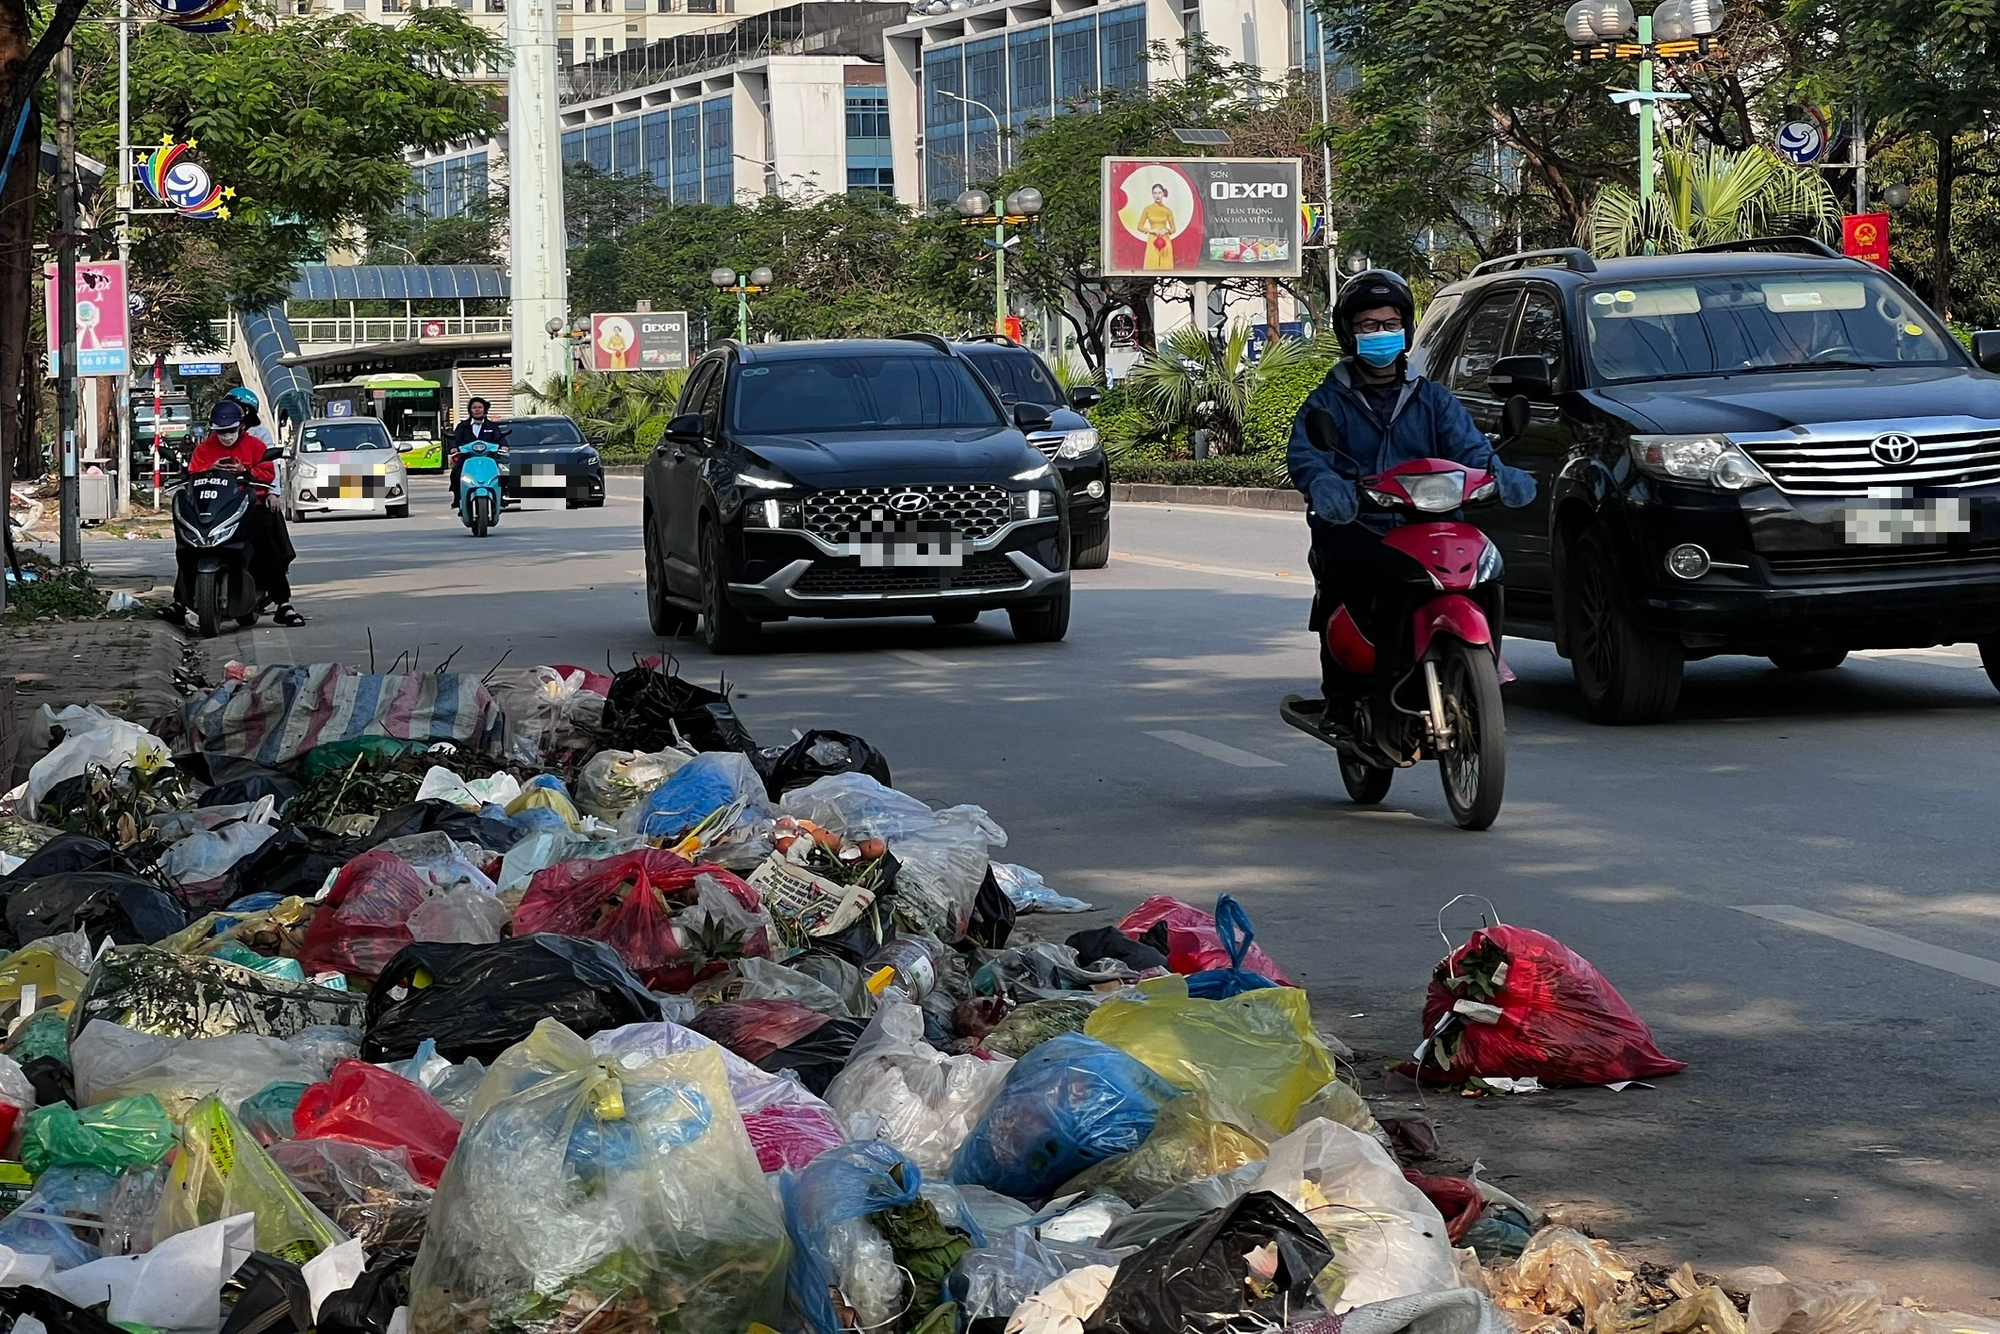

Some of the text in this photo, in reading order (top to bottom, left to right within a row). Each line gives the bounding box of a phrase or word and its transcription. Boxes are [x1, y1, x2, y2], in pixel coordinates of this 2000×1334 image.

[1210, 170, 1228, 178] SƠN
[1210, 181, 1288, 200] OEXPO
[1247, 207, 1273, 216] TRỌNG
[1249, 216, 1266, 225] VIỆT
[1267, 216, 1284, 224] NAM
[642, 323, 680, 333] OEXPO
[199, 490, 218, 499] 150
